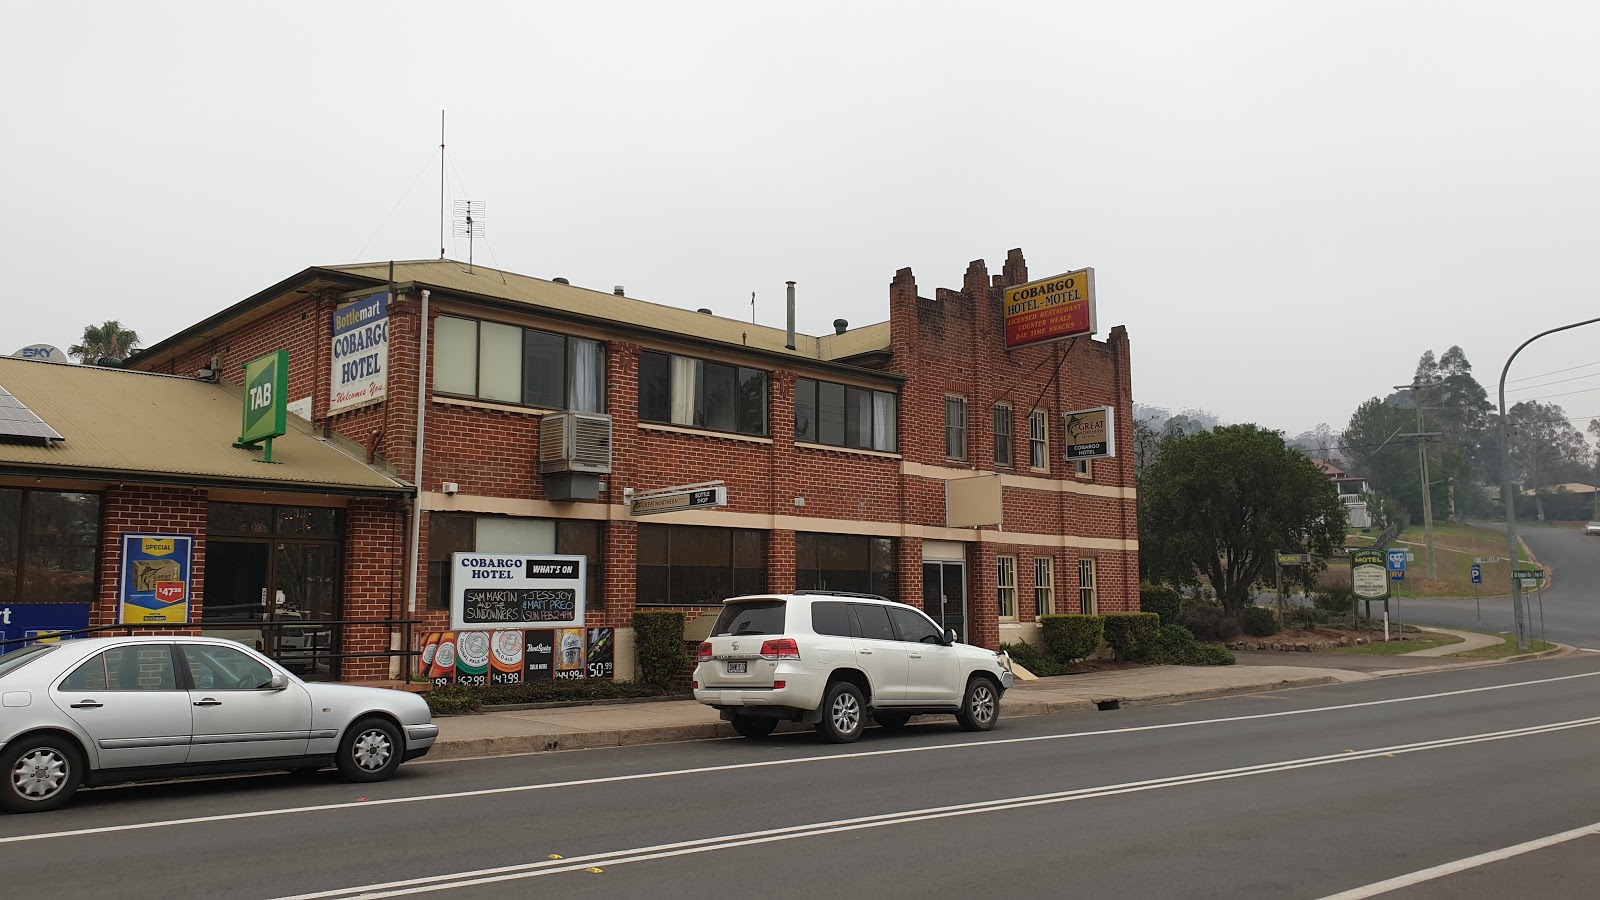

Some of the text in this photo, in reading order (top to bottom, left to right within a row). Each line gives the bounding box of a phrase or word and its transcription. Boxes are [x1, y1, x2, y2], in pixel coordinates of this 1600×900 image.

[1012, 278, 1074, 302] COBARGO
[336, 300, 380, 330] Bottlemart
[1008, 304, 1082, 326] LICENSED RESTAURANT
[1018, 314, 1072, 331] COUNTER MEALS
[1015, 322, 1075, 340] DAY TIME SNACKS
[342, 352, 381, 384] HOTEL
[250, 382, 272, 410] TAB
[1079, 421, 1104, 430] GREAT
[461, 559, 523, 568] COBARGO
[533, 565, 560, 574] WHAT'S
[1472, 570, 1479, 578] P
[472, 570, 513, 579] HOTEL
[467, 591, 517, 602] SAM MARTIN
[556, 591, 572, 600] JOY
[467, 608, 518, 620] SUNDOWNERS
[526, 611, 540, 620] SUN
